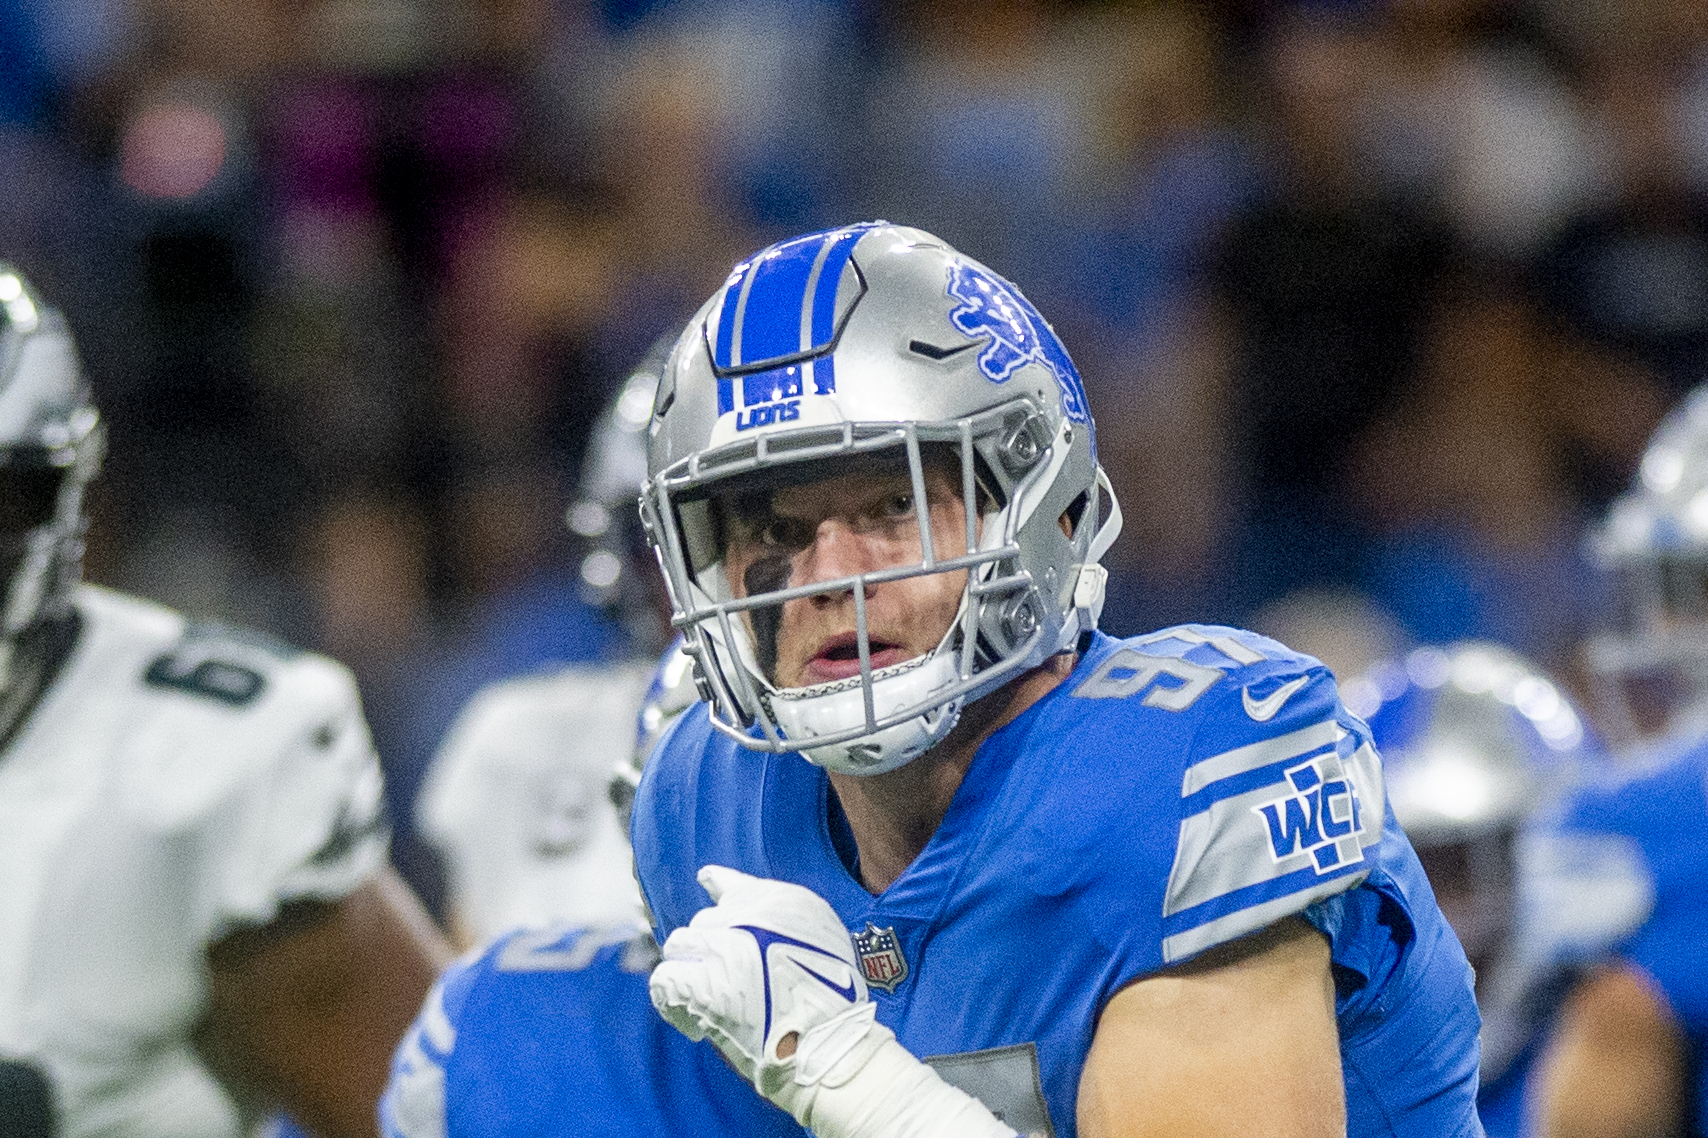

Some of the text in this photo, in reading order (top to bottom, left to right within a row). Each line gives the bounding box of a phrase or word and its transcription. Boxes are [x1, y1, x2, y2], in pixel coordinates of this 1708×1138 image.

[736, 400, 801, 432] LIONS
[1070, 628, 1267, 712] 97
[863, 953, 900, 979] NFL
